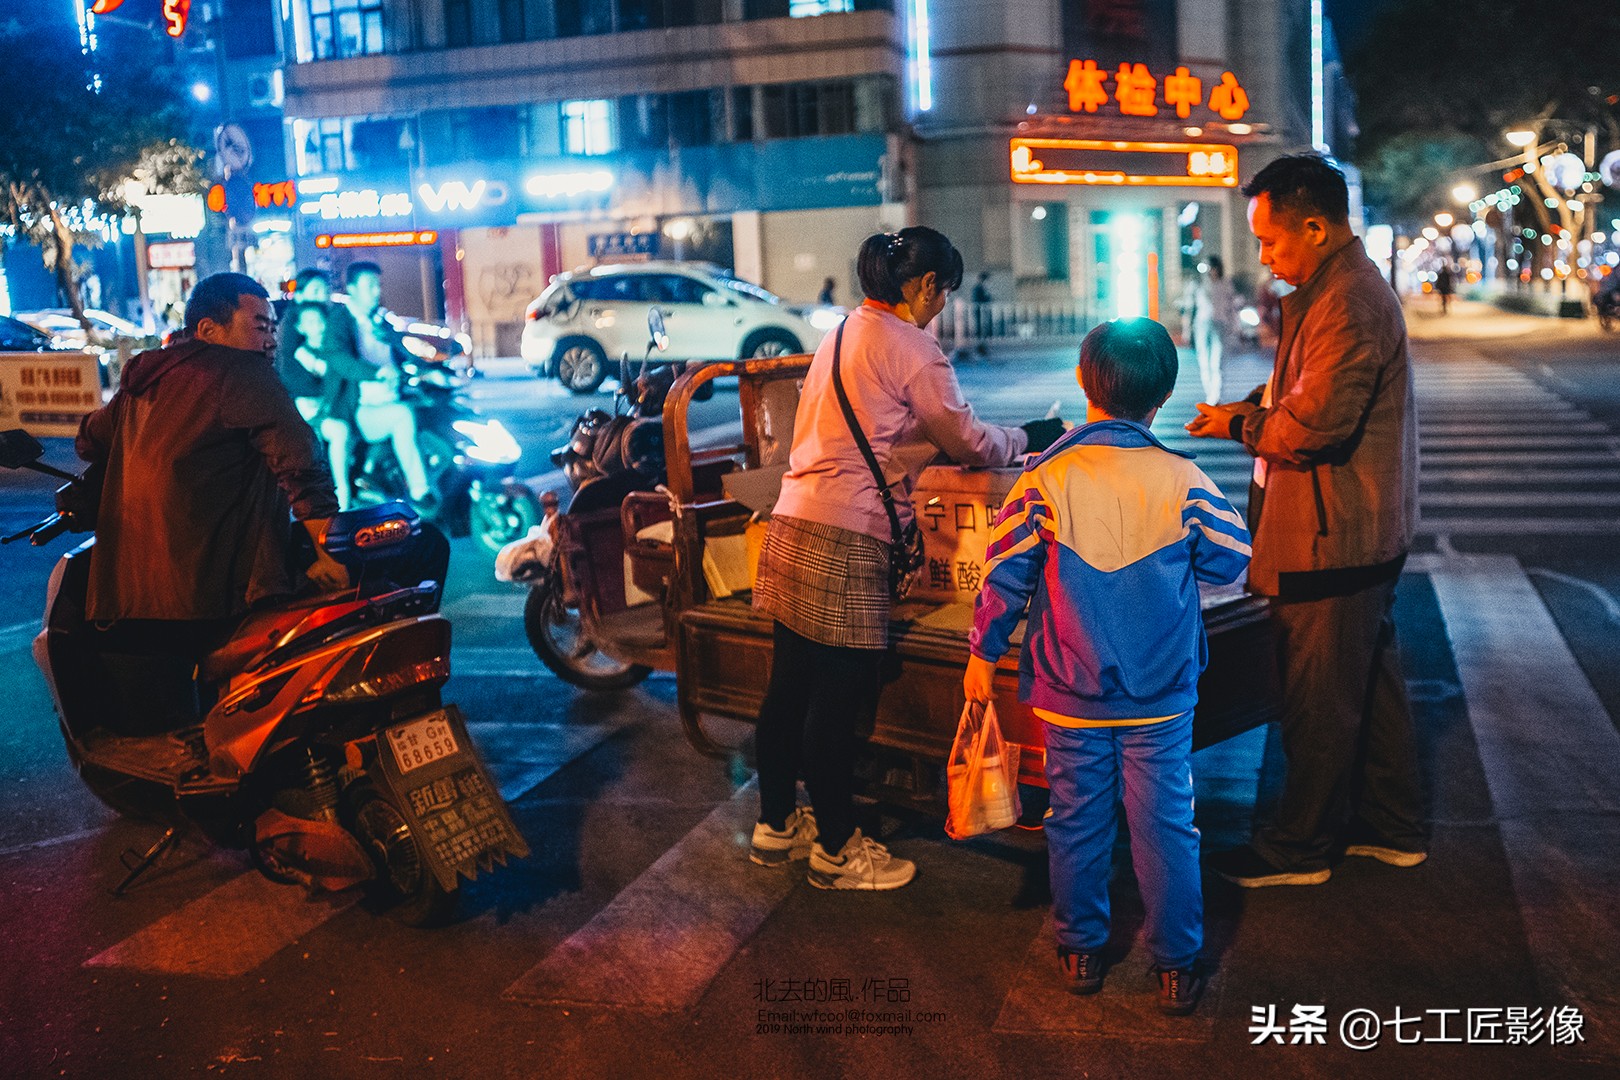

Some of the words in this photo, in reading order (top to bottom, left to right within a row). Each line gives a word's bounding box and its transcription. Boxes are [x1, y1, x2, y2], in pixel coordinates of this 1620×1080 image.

[1064, 58, 1250, 120] 体检中心
[402, 738, 453, 768] 68659
